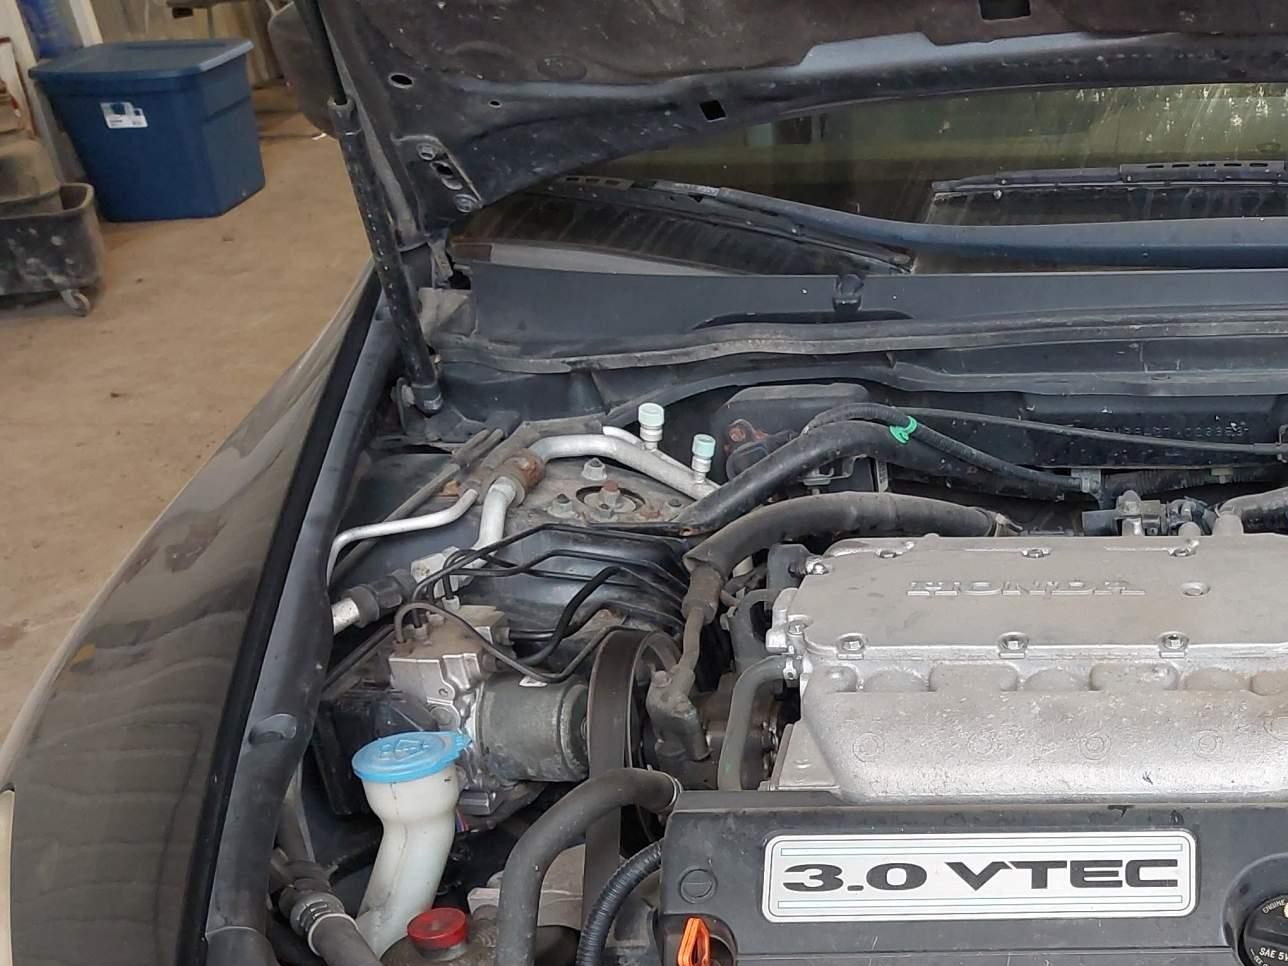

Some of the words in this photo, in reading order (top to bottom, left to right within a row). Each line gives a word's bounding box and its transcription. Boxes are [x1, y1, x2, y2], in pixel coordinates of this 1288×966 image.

[906, 579, 1146, 597] HONDA
[783, 862, 927, 892] 3.0
[945, 859, 1178, 890] VTEC
[1262, 899, 1286, 913] ENGINE
[1259, 947, 1276, 959] SAE
